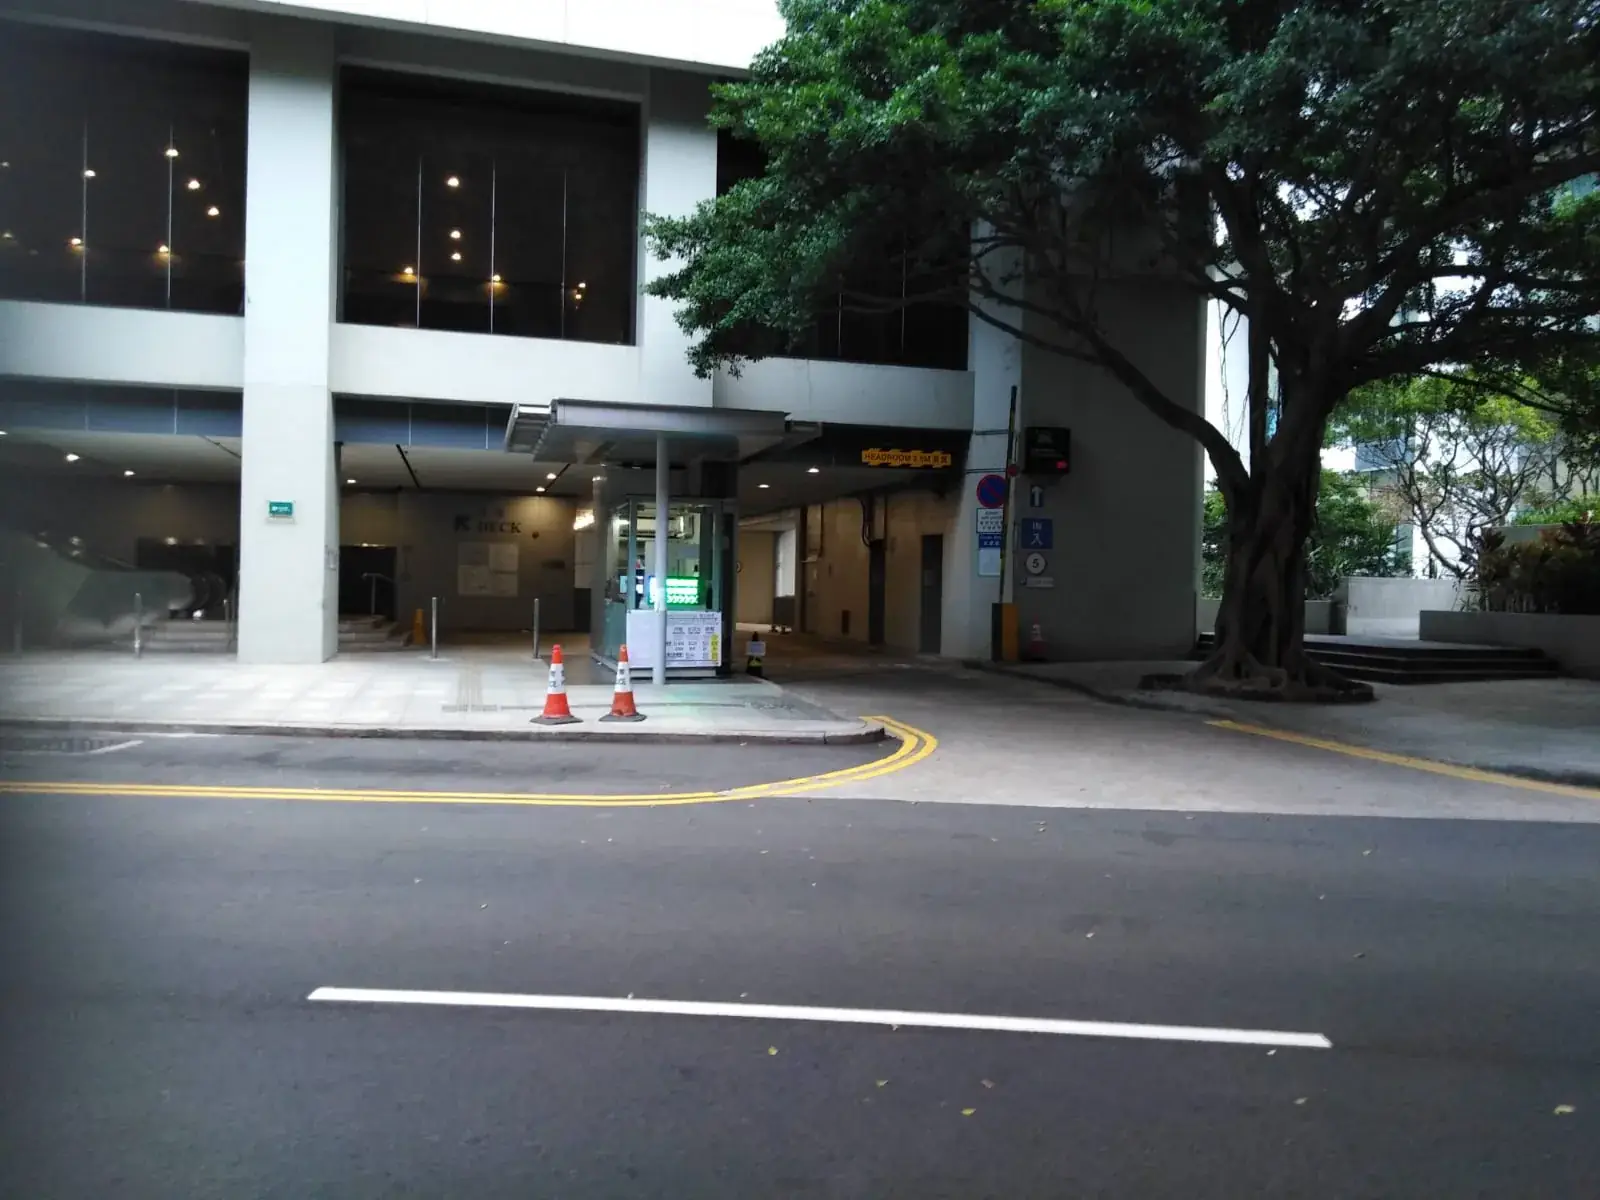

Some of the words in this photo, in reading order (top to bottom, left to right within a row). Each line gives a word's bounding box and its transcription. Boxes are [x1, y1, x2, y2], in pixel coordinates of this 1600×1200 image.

[864, 452, 911, 463] HEADROOM
[1032, 521, 1043, 530] IN
[1030, 533, 1044, 546] 入
[1032, 558, 1040, 569] 5
